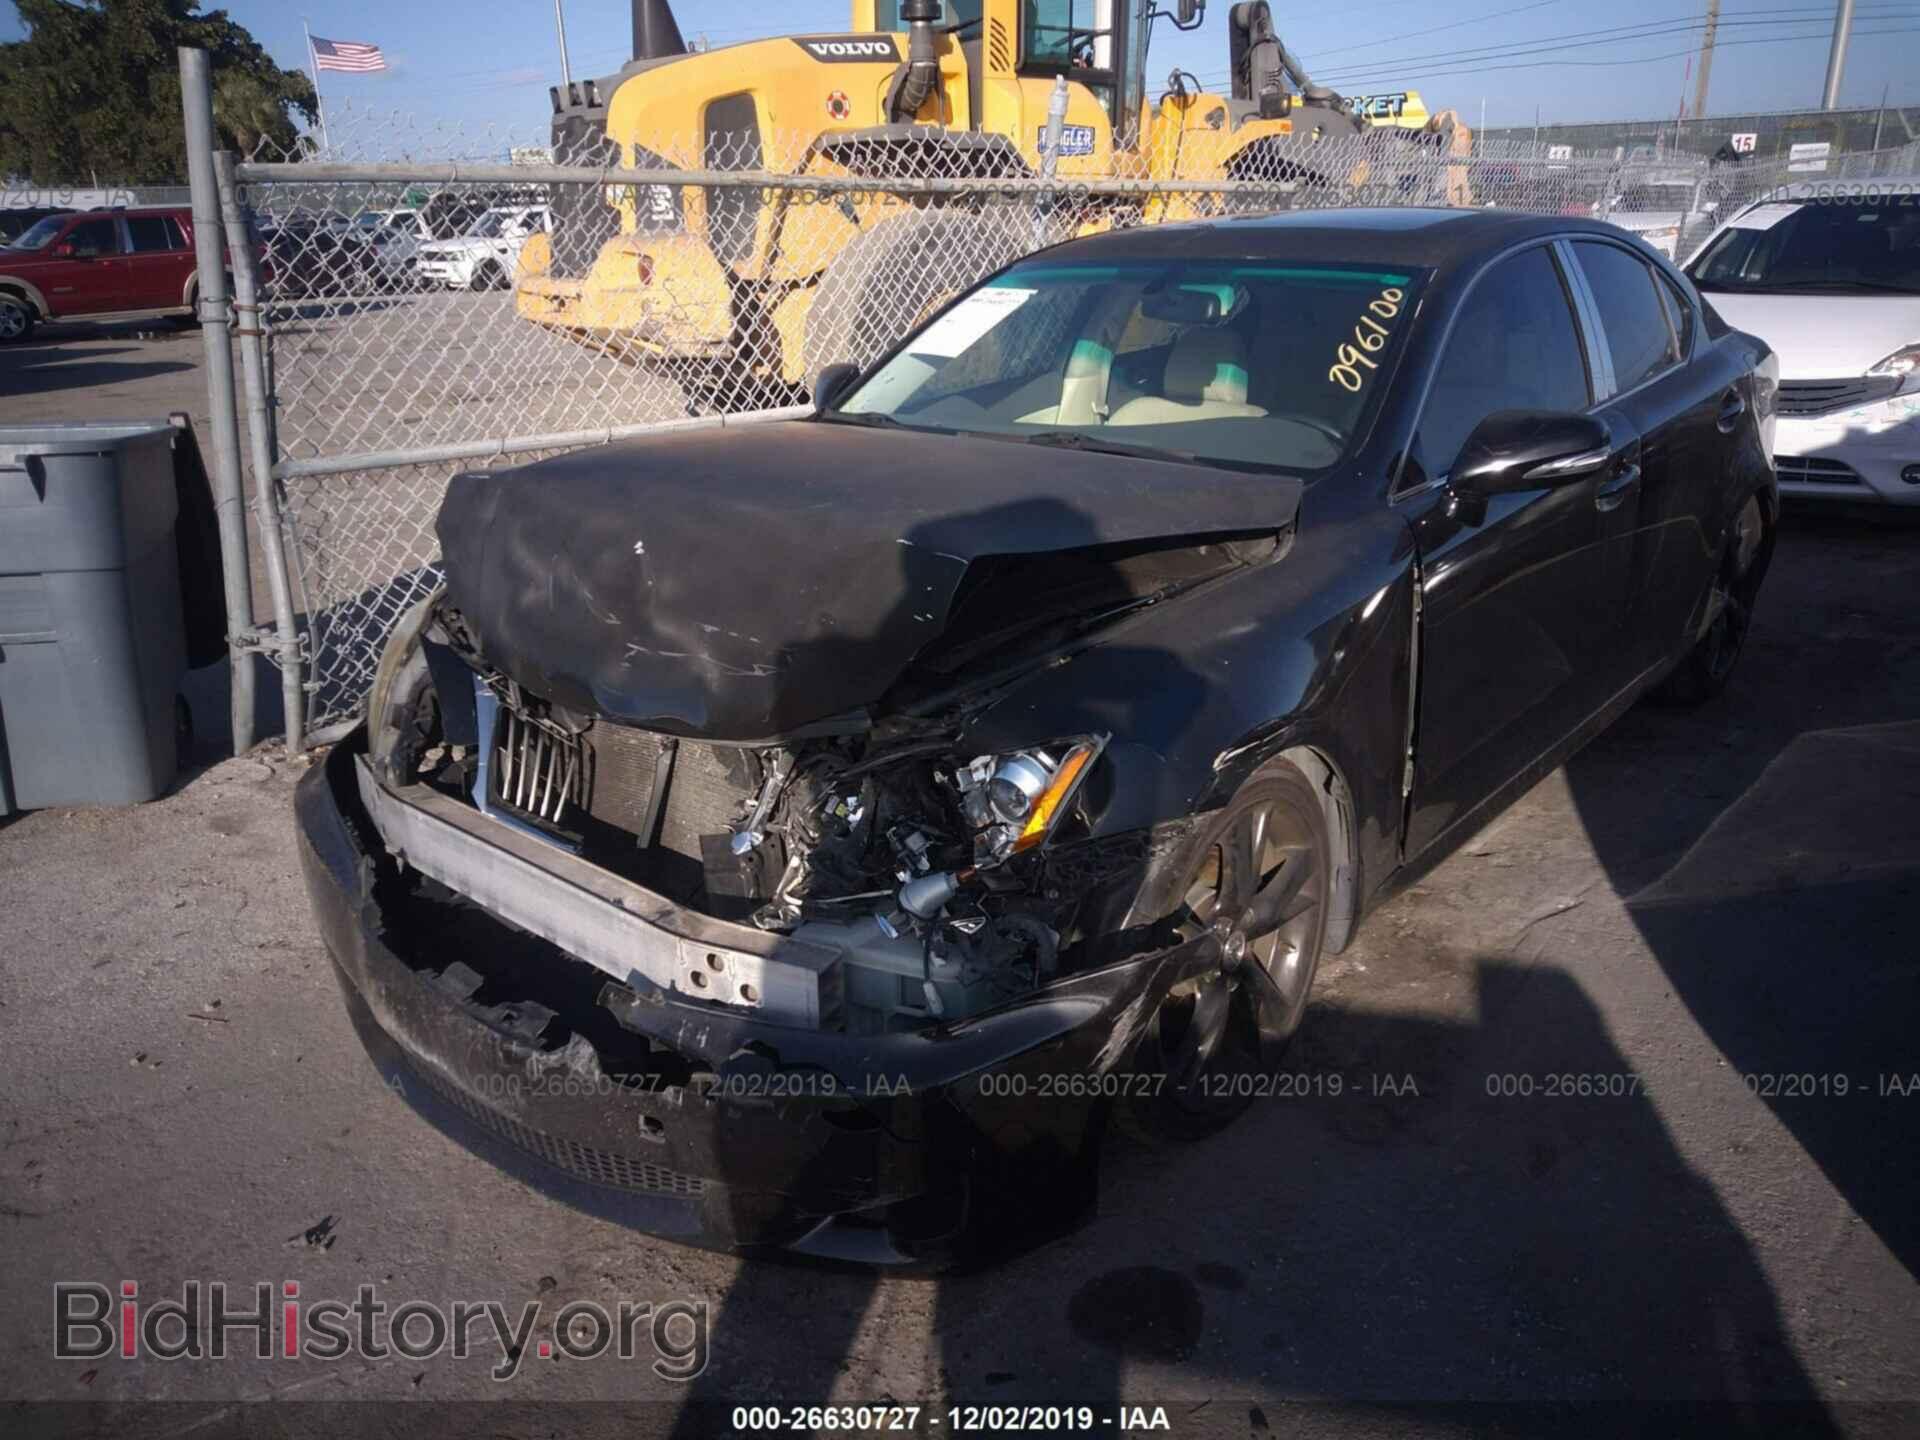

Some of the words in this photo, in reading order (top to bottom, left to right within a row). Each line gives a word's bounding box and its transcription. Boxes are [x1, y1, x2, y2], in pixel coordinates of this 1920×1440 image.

[808, 42, 890, 55] VOLVO
[1735, 137, 1753, 152] 15
[1329, 288, 1403, 392] 096100
